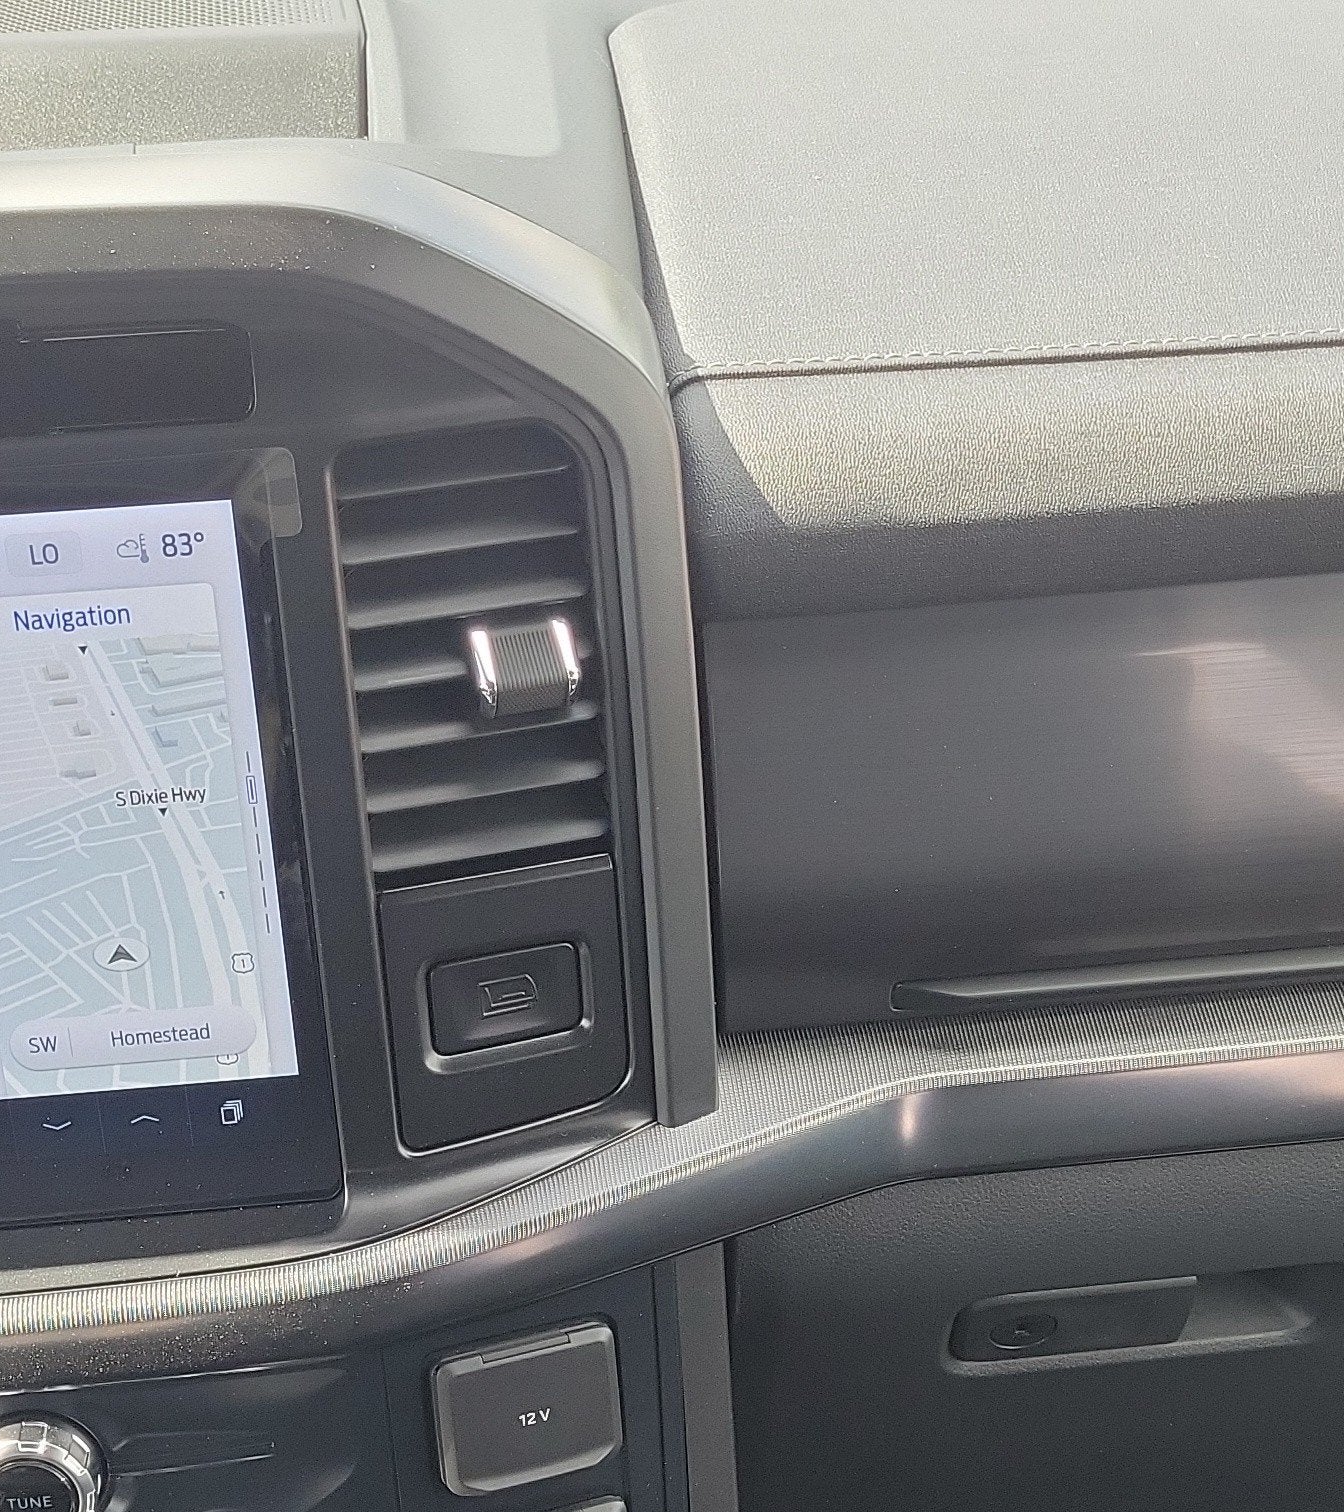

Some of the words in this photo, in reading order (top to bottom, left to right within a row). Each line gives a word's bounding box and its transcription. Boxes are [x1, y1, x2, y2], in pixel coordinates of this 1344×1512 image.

[29, 543, 60, 566] LO
[13, 604, 132, 632] Navigation
[115, 791, 127, 807] S
[130, 788, 169, 806] Dixie
[171, 786, 207, 805] Hwy
[28, 1035, 58, 1054] SW
[110, 1022, 211, 1048] Homestead
[518, 1411, 537, 1428] 12
[538, 1407, 552, 1423] V
[6, 1495, 53, 1511] TUNE
